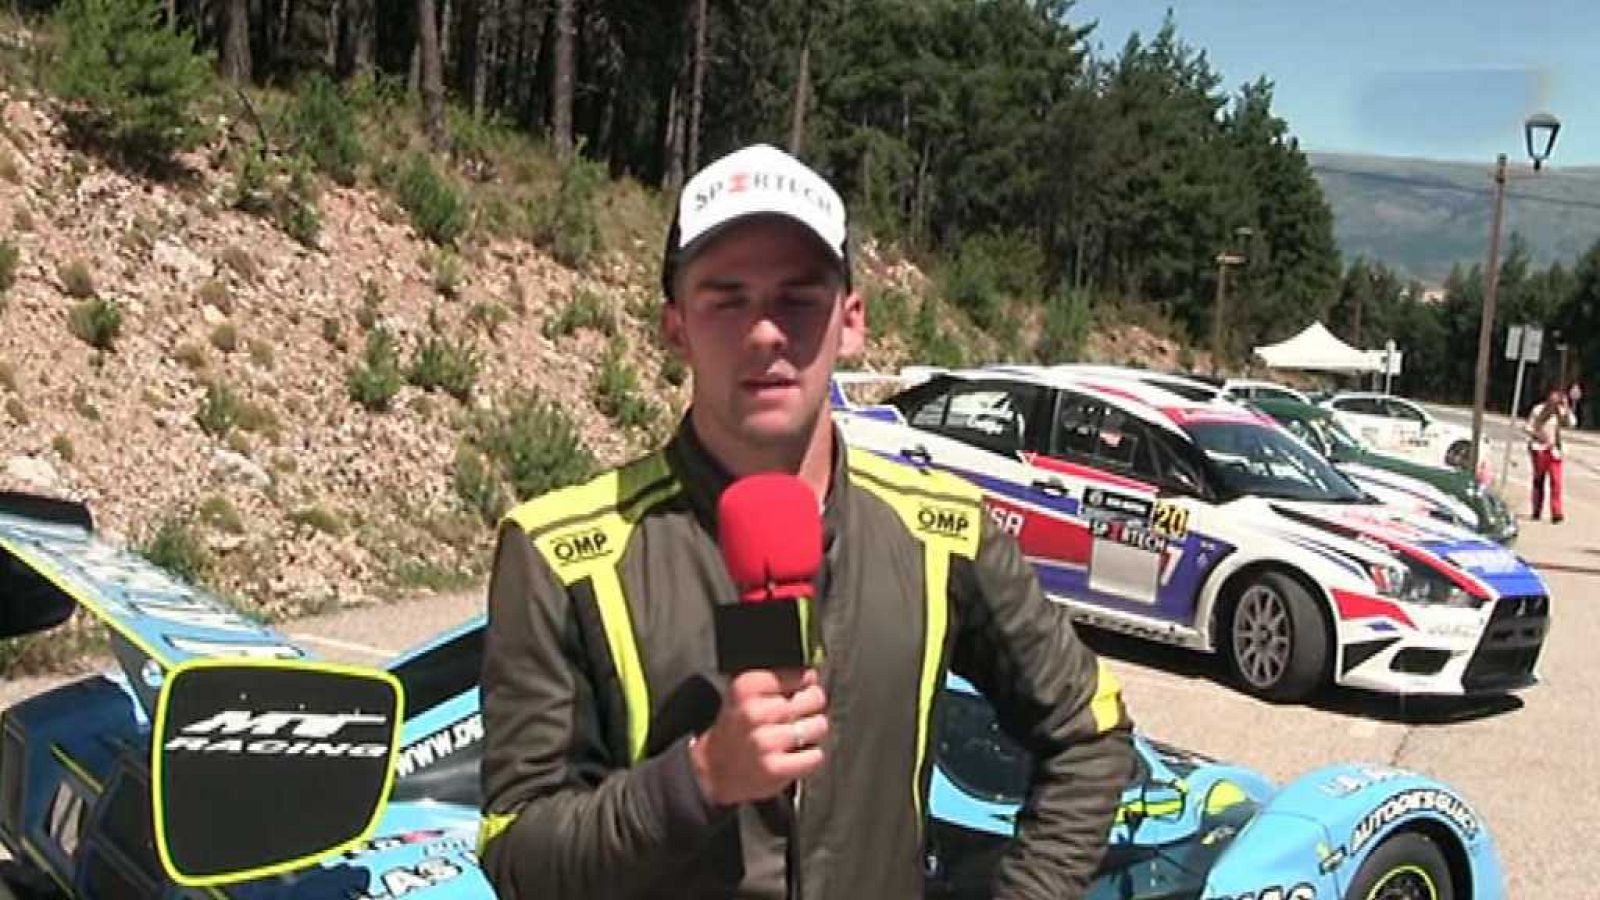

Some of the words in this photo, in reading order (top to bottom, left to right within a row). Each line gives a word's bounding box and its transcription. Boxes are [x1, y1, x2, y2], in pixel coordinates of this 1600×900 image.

[918, 508, 969, 532] OMP
[554, 532, 607, 560] OMP
[164, 736, 389, 758] RACING
